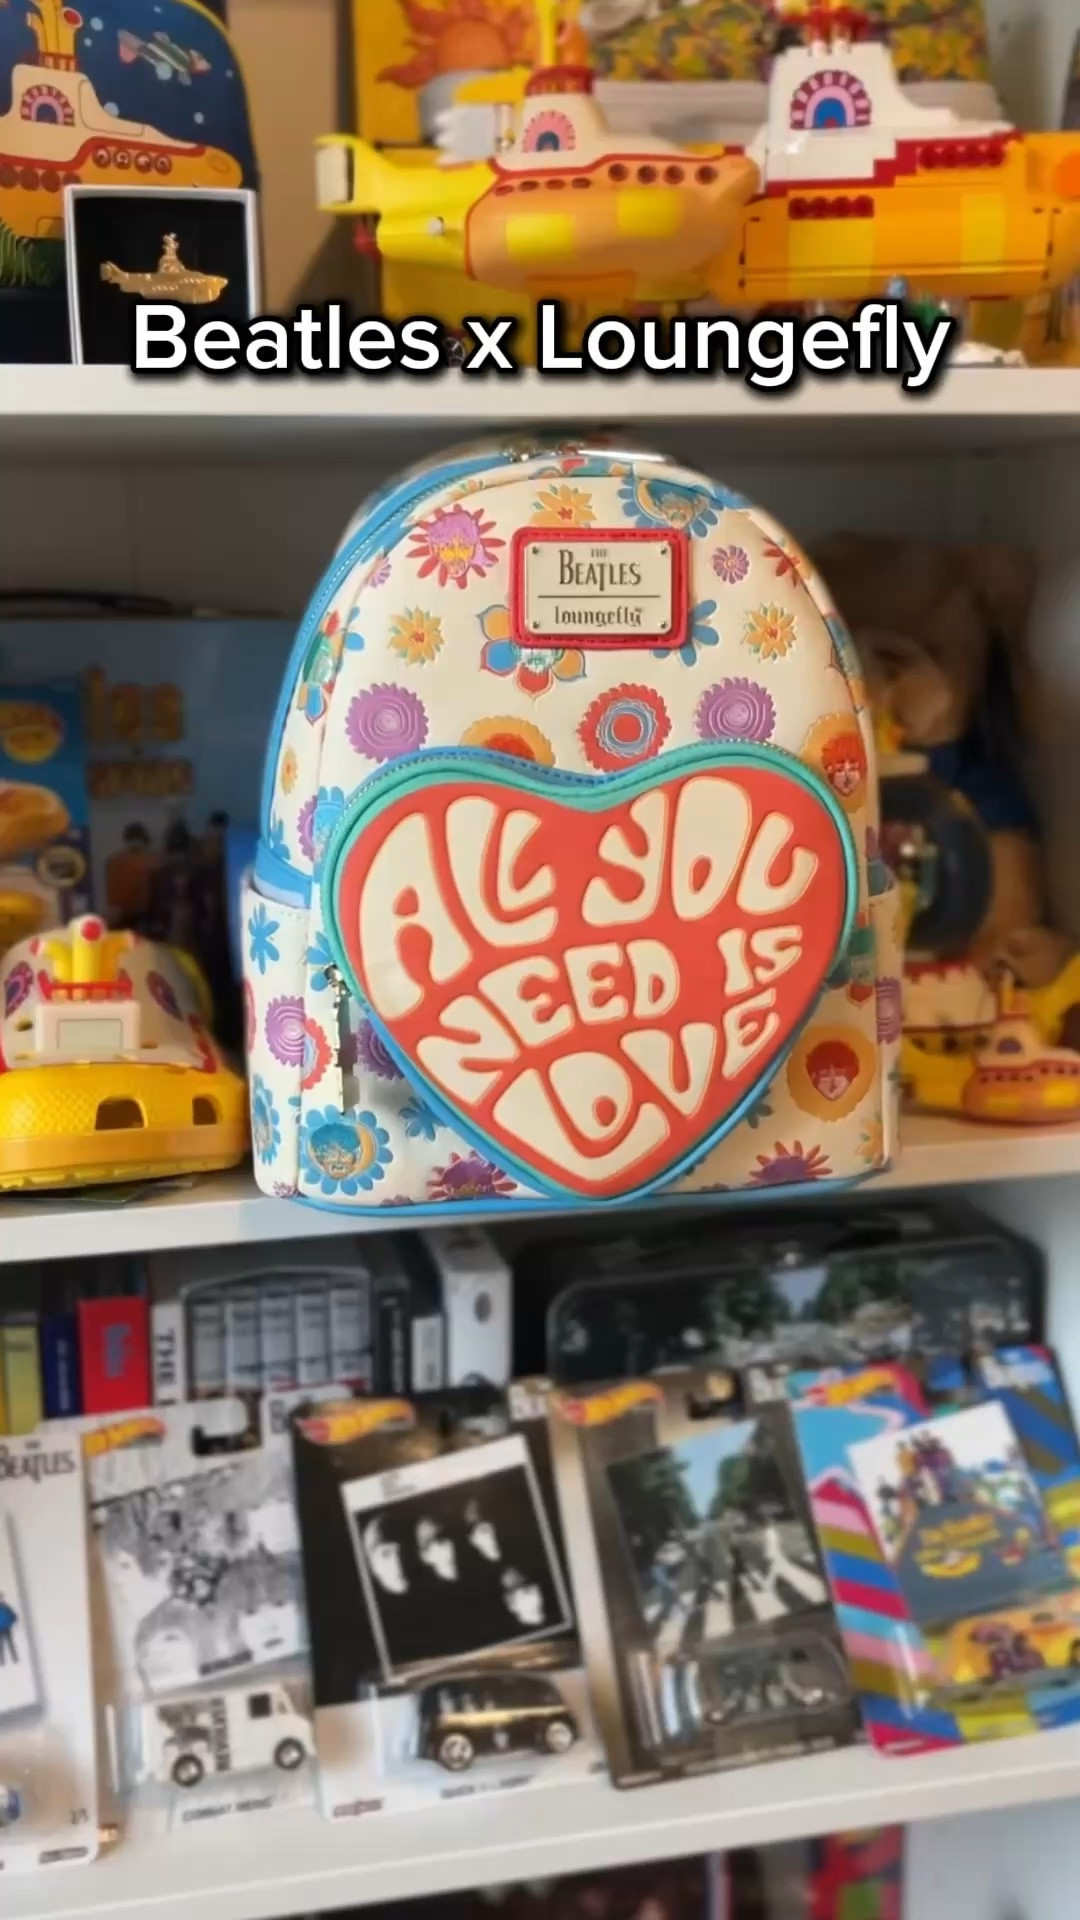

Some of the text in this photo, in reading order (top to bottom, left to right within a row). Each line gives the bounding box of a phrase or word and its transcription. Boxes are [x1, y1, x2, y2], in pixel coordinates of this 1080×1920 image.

[558, 549, 642, 591] BEATLES
[359, 775, 819, 1020] ALL YOU
[415, 925, 804, 1106] NEED IS
[492, 986, 780, 1182] LOVE
